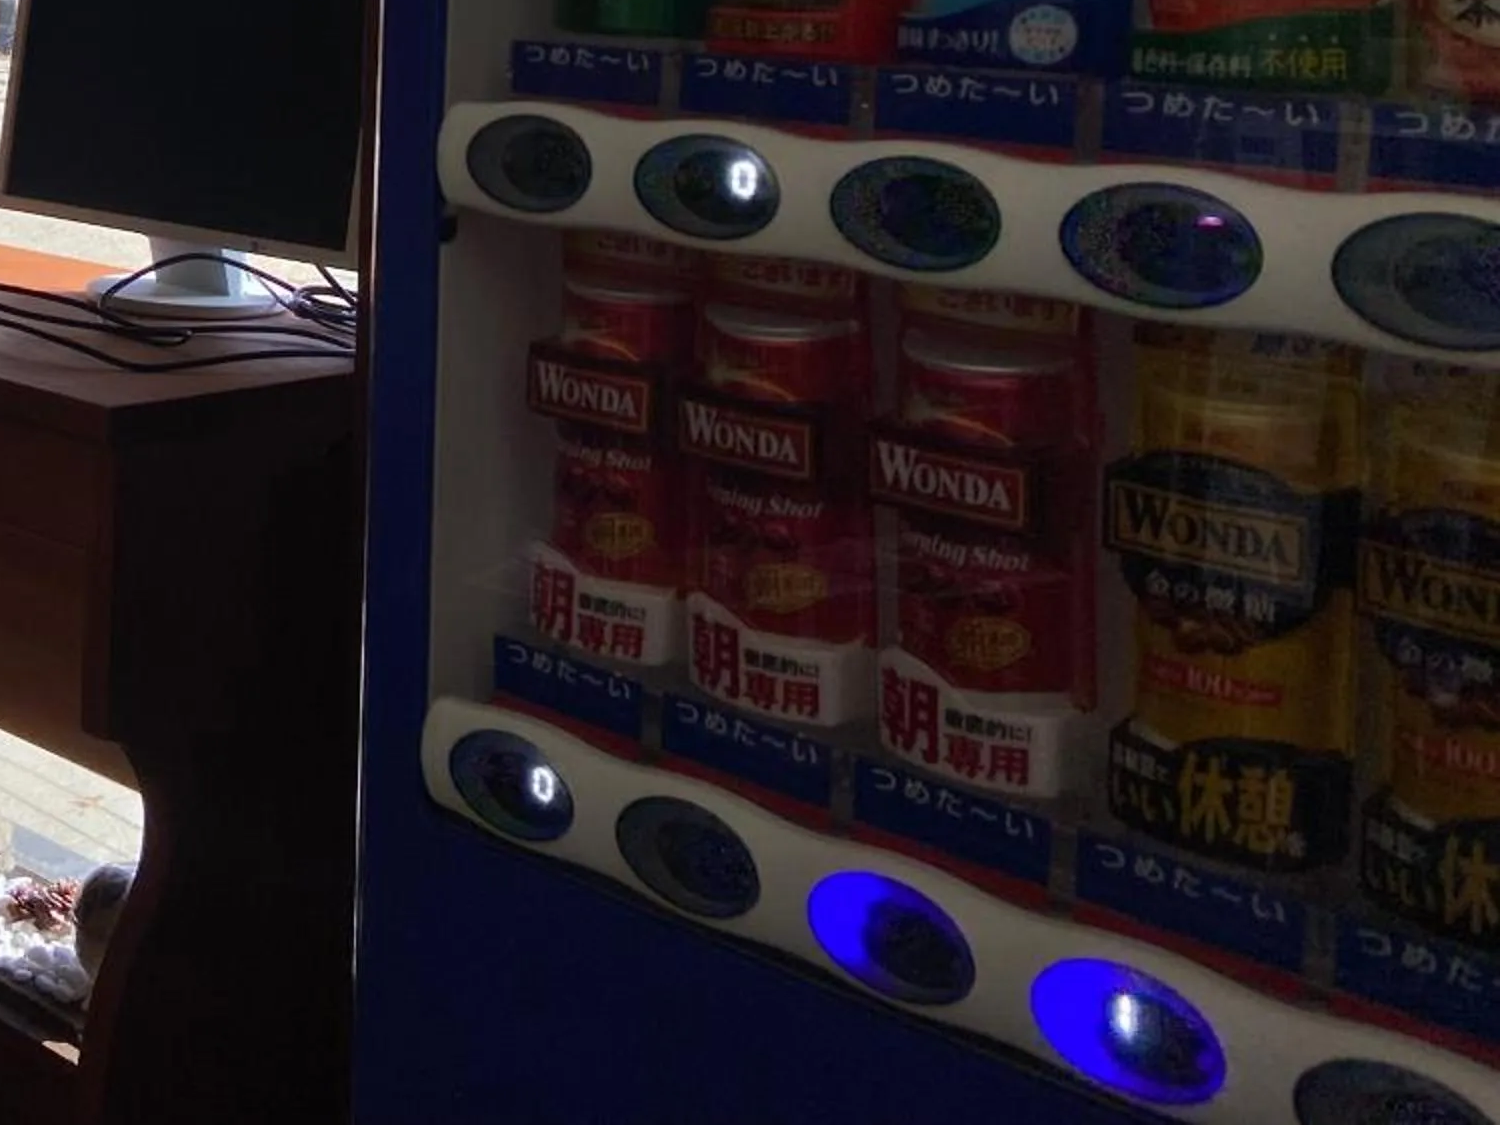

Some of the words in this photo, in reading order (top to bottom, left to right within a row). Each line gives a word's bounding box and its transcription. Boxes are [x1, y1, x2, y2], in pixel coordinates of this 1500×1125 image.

[730, 161, 756, 200] 0
[536, 360, 638, 419] WONDA
[684, 400, 800, 464] WONDA
[769, 490, 824, 519] Shot
[876, 438, 1013, 512] WONDA
[1117, 485, 1294, 568] WONDA
[972, 543, 1030, 573] Shot
[532, 766, 555, 805] 0
[1356, 926, 1500, 993] つめた
